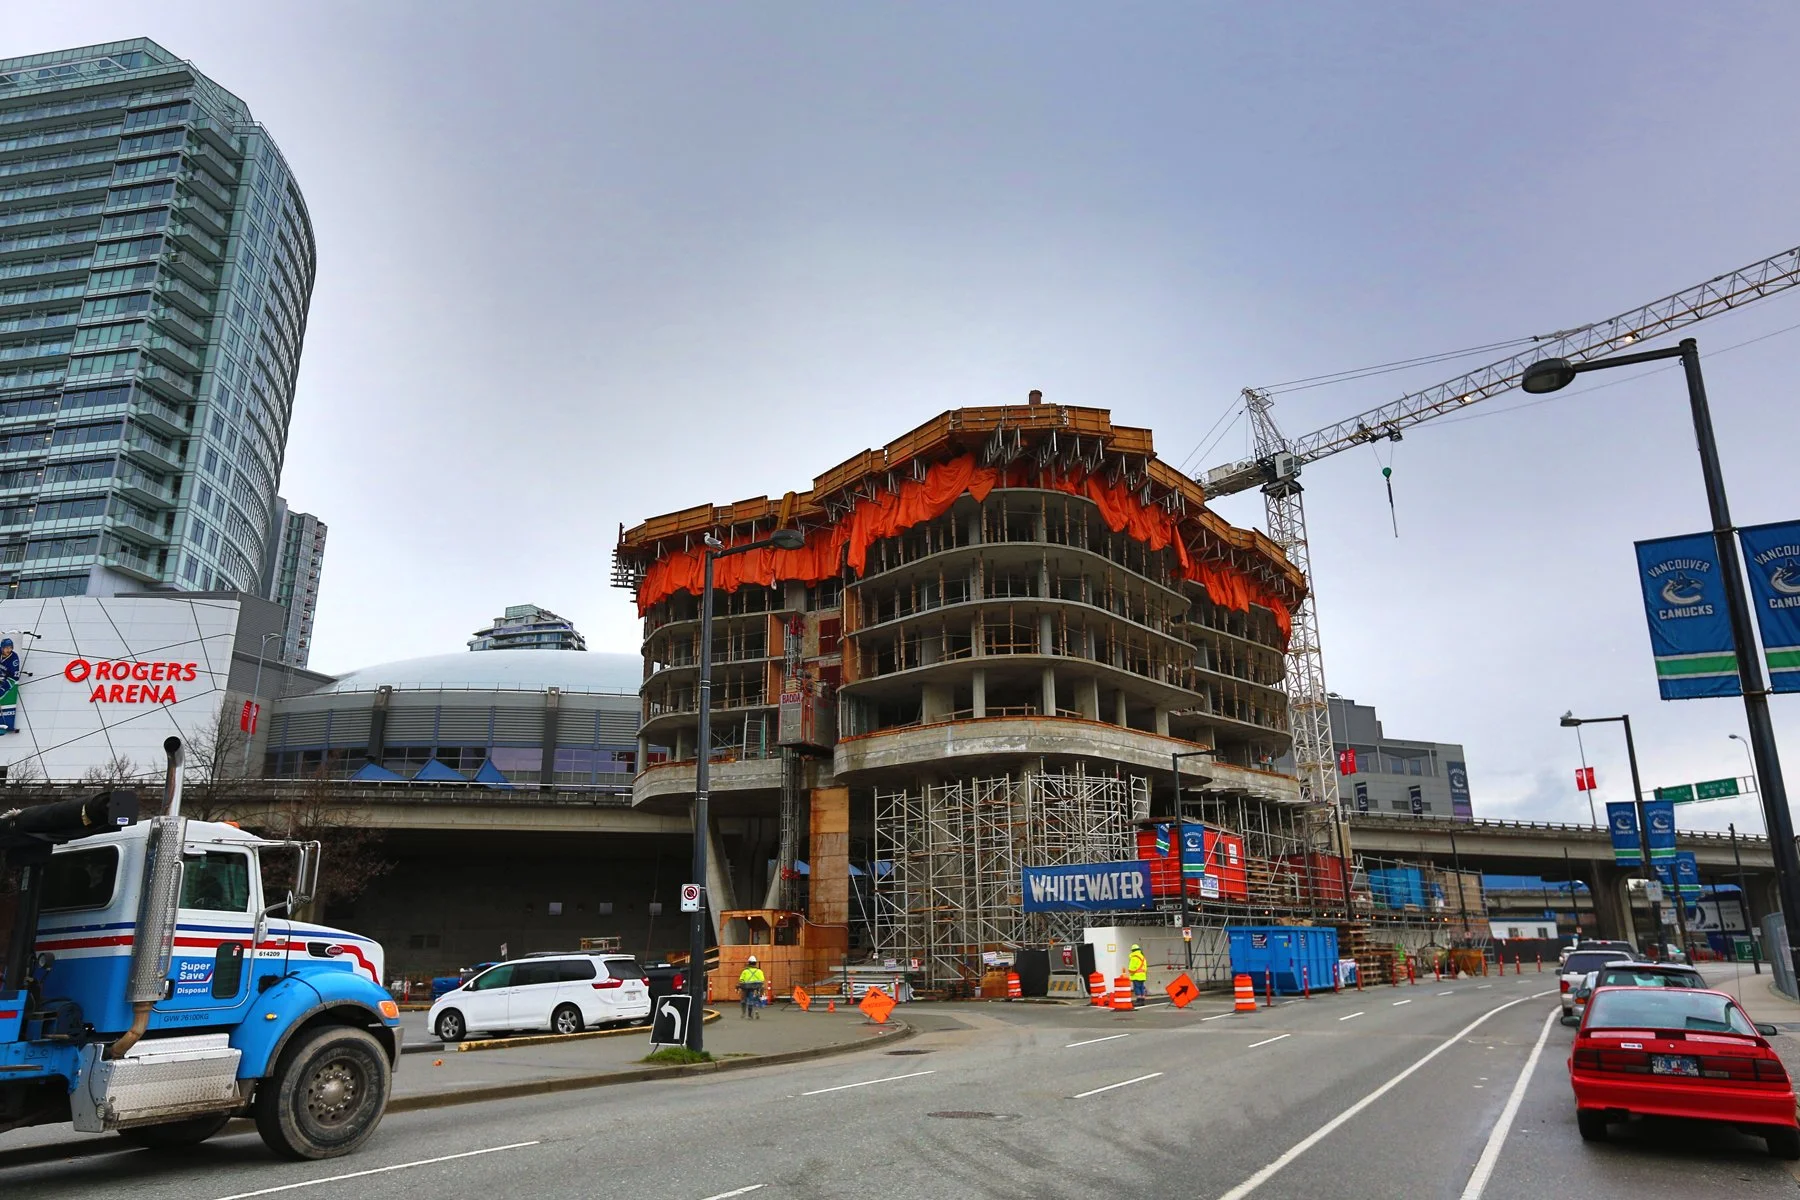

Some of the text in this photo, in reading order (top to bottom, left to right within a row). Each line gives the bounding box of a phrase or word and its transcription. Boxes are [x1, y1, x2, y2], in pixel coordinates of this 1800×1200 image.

[1648, 559, 1710, 578] VANCOUVER
[1659, 604, 1713, 620] CANUCKS
[95, 661, 197, 682] ROGERS
[89, 684, 177, 703] ARENA
[1029, 871, 1145, 903] WHITEWATER
[180, 961, 211, 972] Super
[179, 971, 205, 980] Save
[177, 987, 208, 995] Disposal
